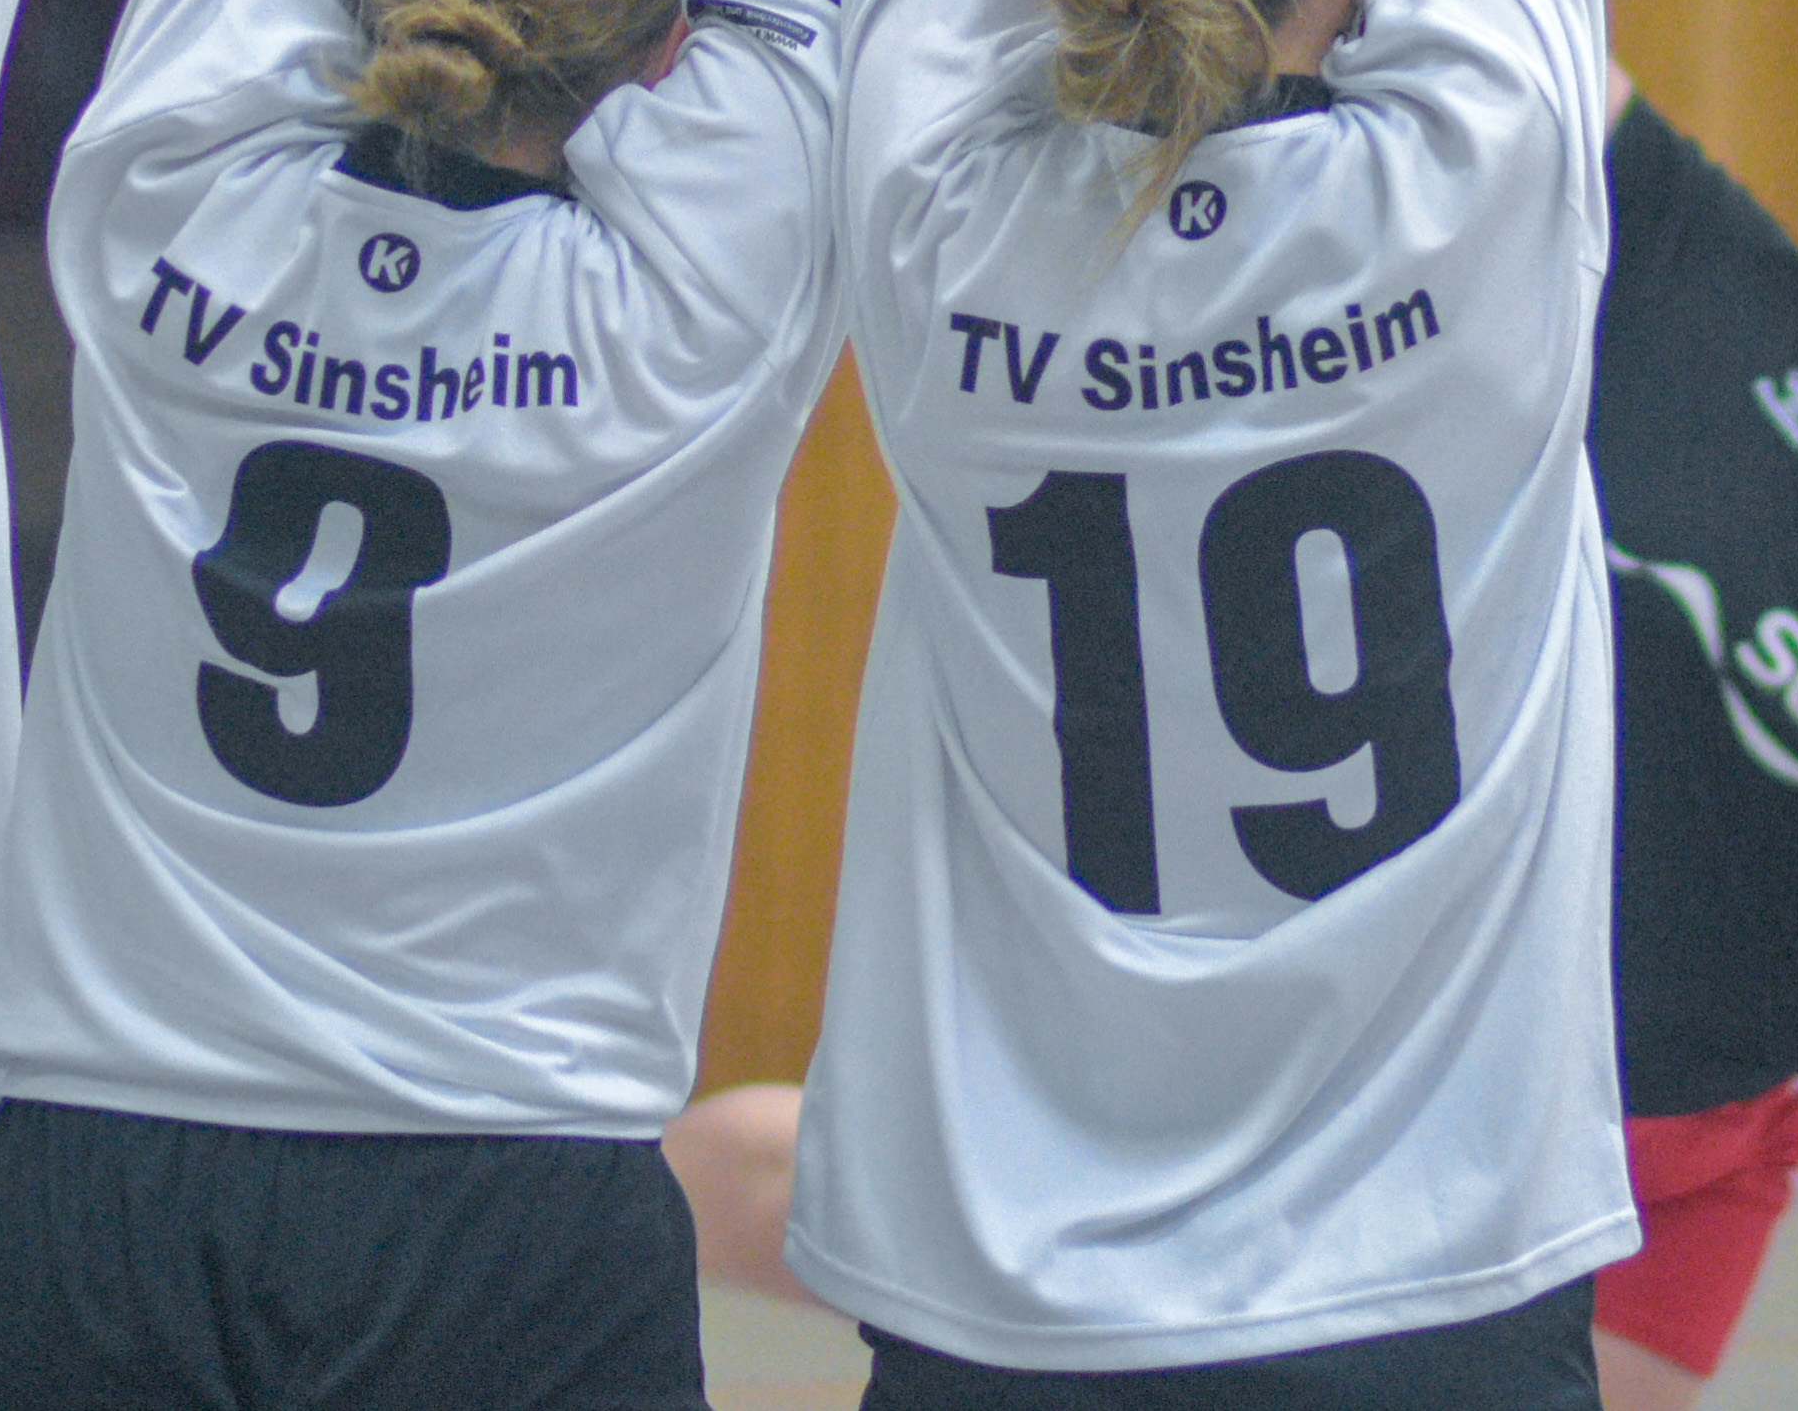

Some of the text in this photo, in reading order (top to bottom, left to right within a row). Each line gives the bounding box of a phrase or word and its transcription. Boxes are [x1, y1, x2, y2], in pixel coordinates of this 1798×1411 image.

[139, 257, 578, 422] TV Sinsheim
[949, 289, 1441, 412] TV Sinsheim
[191, 439, 453, 809] 9
[985, 449, 1463, 917] 19
